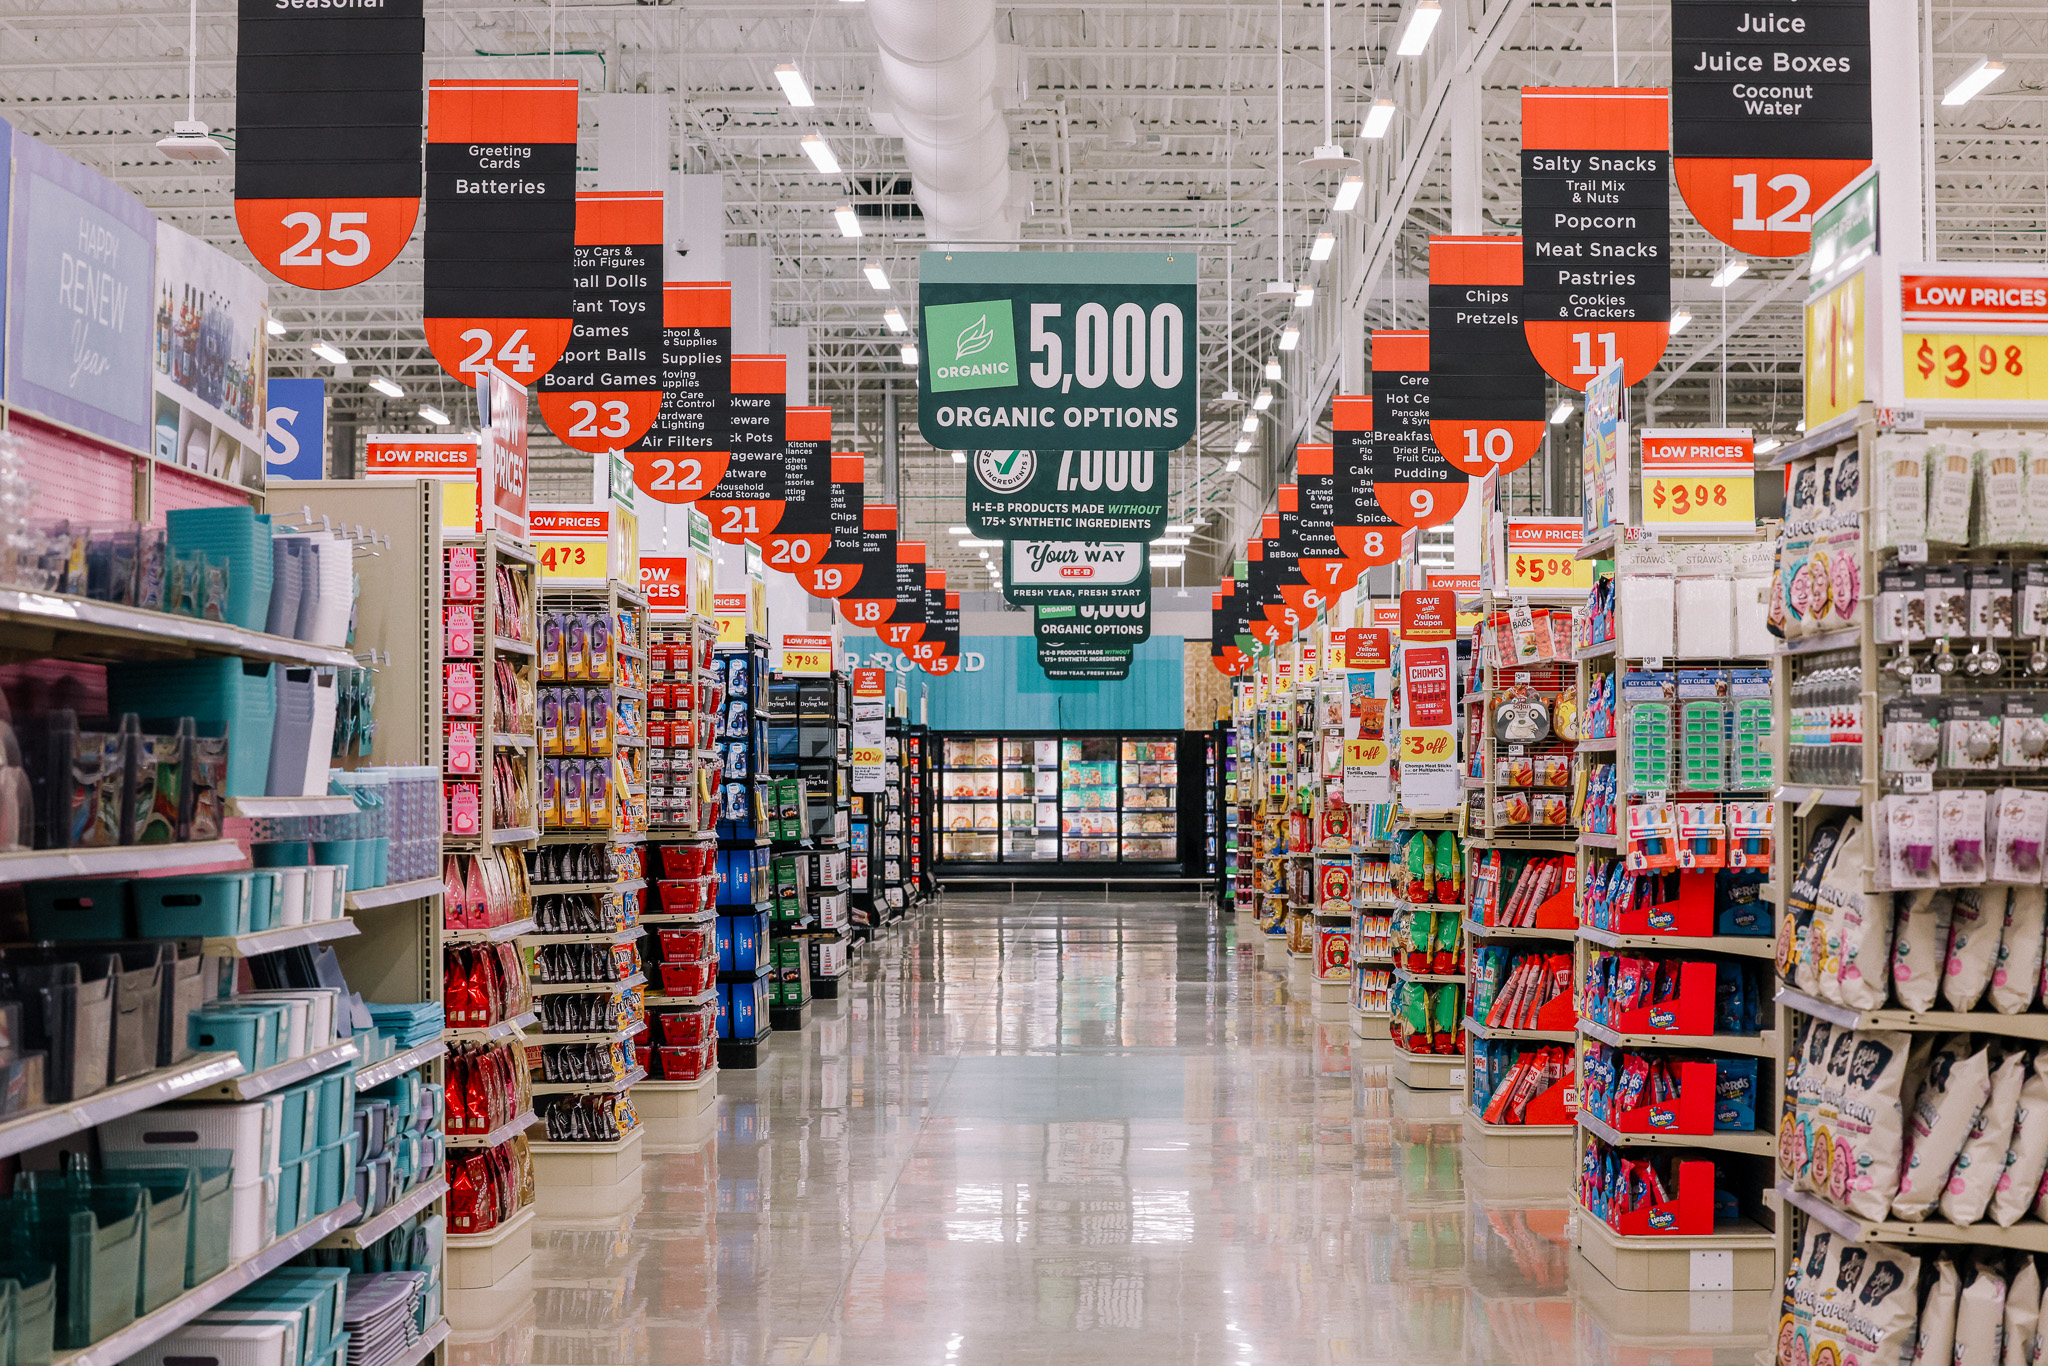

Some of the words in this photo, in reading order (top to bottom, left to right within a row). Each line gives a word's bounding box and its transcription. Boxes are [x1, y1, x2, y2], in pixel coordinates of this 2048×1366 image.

[1737, 13, 1806, 33] Juice
[1694, 52, 1763, 72] Juice
[1773, 52, 1851, 72] Boxes
[1732, 84, 1813, 99] Coconut
[1744, 100, 1802, 116] Water
[468, 145, 532, 159] Greeting
[479, 157, 521, 169] Cards
[1533, 156, 1582, 173] Salty
[1589, 156, 1657, 171] Snacks
[455, 178, 546, 194] Batteries
[1566, 180, 1596, 191] Trail
[1601, 180, 1625, 191] Mix
[1572, 193, 1582, 203] &
[1587, 193, 1619, 203] Nuts
[1732, 173, 1812, 232] 12
[1554, 214, 1636, 232] Popcorn
[78, 216, 120, 269] HAPPY
[279, 212, 371, 266] 25
[594, 247, 621, 256] Cars
[624, 247, 633, 256] &
[1536, 242, 1582, 257] Meat
[1590, 242, 1658, 257] Snacks
[600, 258, 645, 268] Figures
[606, 275, 647, 287] Dolls
[1558, 271, 1636, 285] Pastries
[59, 252, 128, 334] RENEW
[1466, 290, 1509, 304] Chips
[1914, 287, 1966, 305] LOW
[1970, 287, 2048, 306] PRICES
[1569, 295, 1625, 305] Cookies
[609, 300, 646, 314] Toys
[1559, 307, 1568, 317] &
[1573, 307, 1635, 318] Crackers
[1456, 312, 1519, 325] Pretzels
[573, 325, 629, 337] Games
[673, 338, 718, 347] Supplies
[1029, 302, 1184, 394] 5,000
[69, 319, 110, 388] Year
[458, 329, 536, 373] 24
[607, 348, 646, 361] Balls
[1572, 332, 1617, 374] 11
[662, 353, 722, 366] Supplies
[936, 361, 1010, 379] ORGANIC
[544, 373, 594, 386] Board
[600, 373, 657, 386] Games
[680, 391, 704, 399] Care
[1386, 393, 1409, 403] Hot
[676, 400, 715, 408] Control
[568, 400, 631, 437] 23
[936, 406, 1056, 428] ORGANIC
[1063, 407, 1179, 428] OPTIONS
[499, 403, 519, 446] LOW
[661, 421, 705, 430] Lighting
[641, 436, 665, 447] Air
[668, 436, 713, 447] Filters
[746, 433, 773, 442] Pots
[1393, 446, 1420, 454] Dried
[1463, 428, 1514, 463] 10
[1651, 445, 1687, 458] LOW
[1690, 445, 1744, 458] PRICES
[376, 450, 412, 462] LOW
[414, 450, 468, 462] PRICES
[1396, 454, 1419, 462] Fruit
[1421, 454, 1445, 463] Cups
[494, 443, 524, 498] PRICES
[650, 459, 703, 490] 22
[1394, 467, 1448, 481] Pudding
[735, 491, 771, 499] Storage
[972, 503, 1004, 512] H-E-B
[1007, 503, 1069, 513] PRODUCTS
[1071, 504, 1104, 514] MADE
[1107, 504, 1162, 515] WITHOUT
[1409, 489, 1434, 518] 9
[529, 517, 556, 527] LOW
[558, 517, 601, 527] PRICES
[720, 506, 760, 533] 21
[830, 512, 857, 521] Chips
[981, 517, 1006, 526] 175+
[1009, 517, 1073, 528] SYNTHETIC
[1075, 518, 1151, 529] INGREDIENTS
[1356, 513, 1393, 524] Spices
[835, 526, 859, 534] Fluid
[1515, 529, 1550, 539] LOW
[835, 540, 860, 548] Tools
[1363, 532, 1384, 557] 8
[771, 539, 812, 563] 20
[1303, 547, 1340, 555] Canned
[1026, 544, 1079, 573] Your
[1085, 550, 1126, 562] WAY
[1629, 555, 1666, 564] STRAWS
[1686, 555, 1723, 564] STRAWS
[813, 569, 842, 590] 19
[1325, 563, 1343, 585] 7
[1432, 580, 1453, 588] LOW
[1013, 589, 1044, 597] FRESH
[1047, 589, 1075, 598] YEAR,
[1078, 589, 1108, 597] FRESH
[1111, 589, 1141, 597] START
[1416, 597, 1440, 605] SAVE
[854, 602, 880, 621] 18
[1284, 608, 1299, 626] 5
[1041, 624, 1092, 634] ORGANIC
[1094, 625, 1144, 634] OPTIONS
[1413, 619, 1443, 627] Coupon
[1512, 619, 1532, 629] BAGS
[890, 626, 911, 642] 17
[1265, 625, 1279, 640] 4
[912, 644, 933, 659] 16
[1251, 638, 1263, 652] 3
[930, 658, 948, 671] 15
[1411, 667, 1444, 680] CHOMPS
[1404, 736, 1425, 754] $3
[1426, 736, 1448, 754] off
[1347, 745, 1361, 760] $1
[1362, 746, 1381, 760] off
